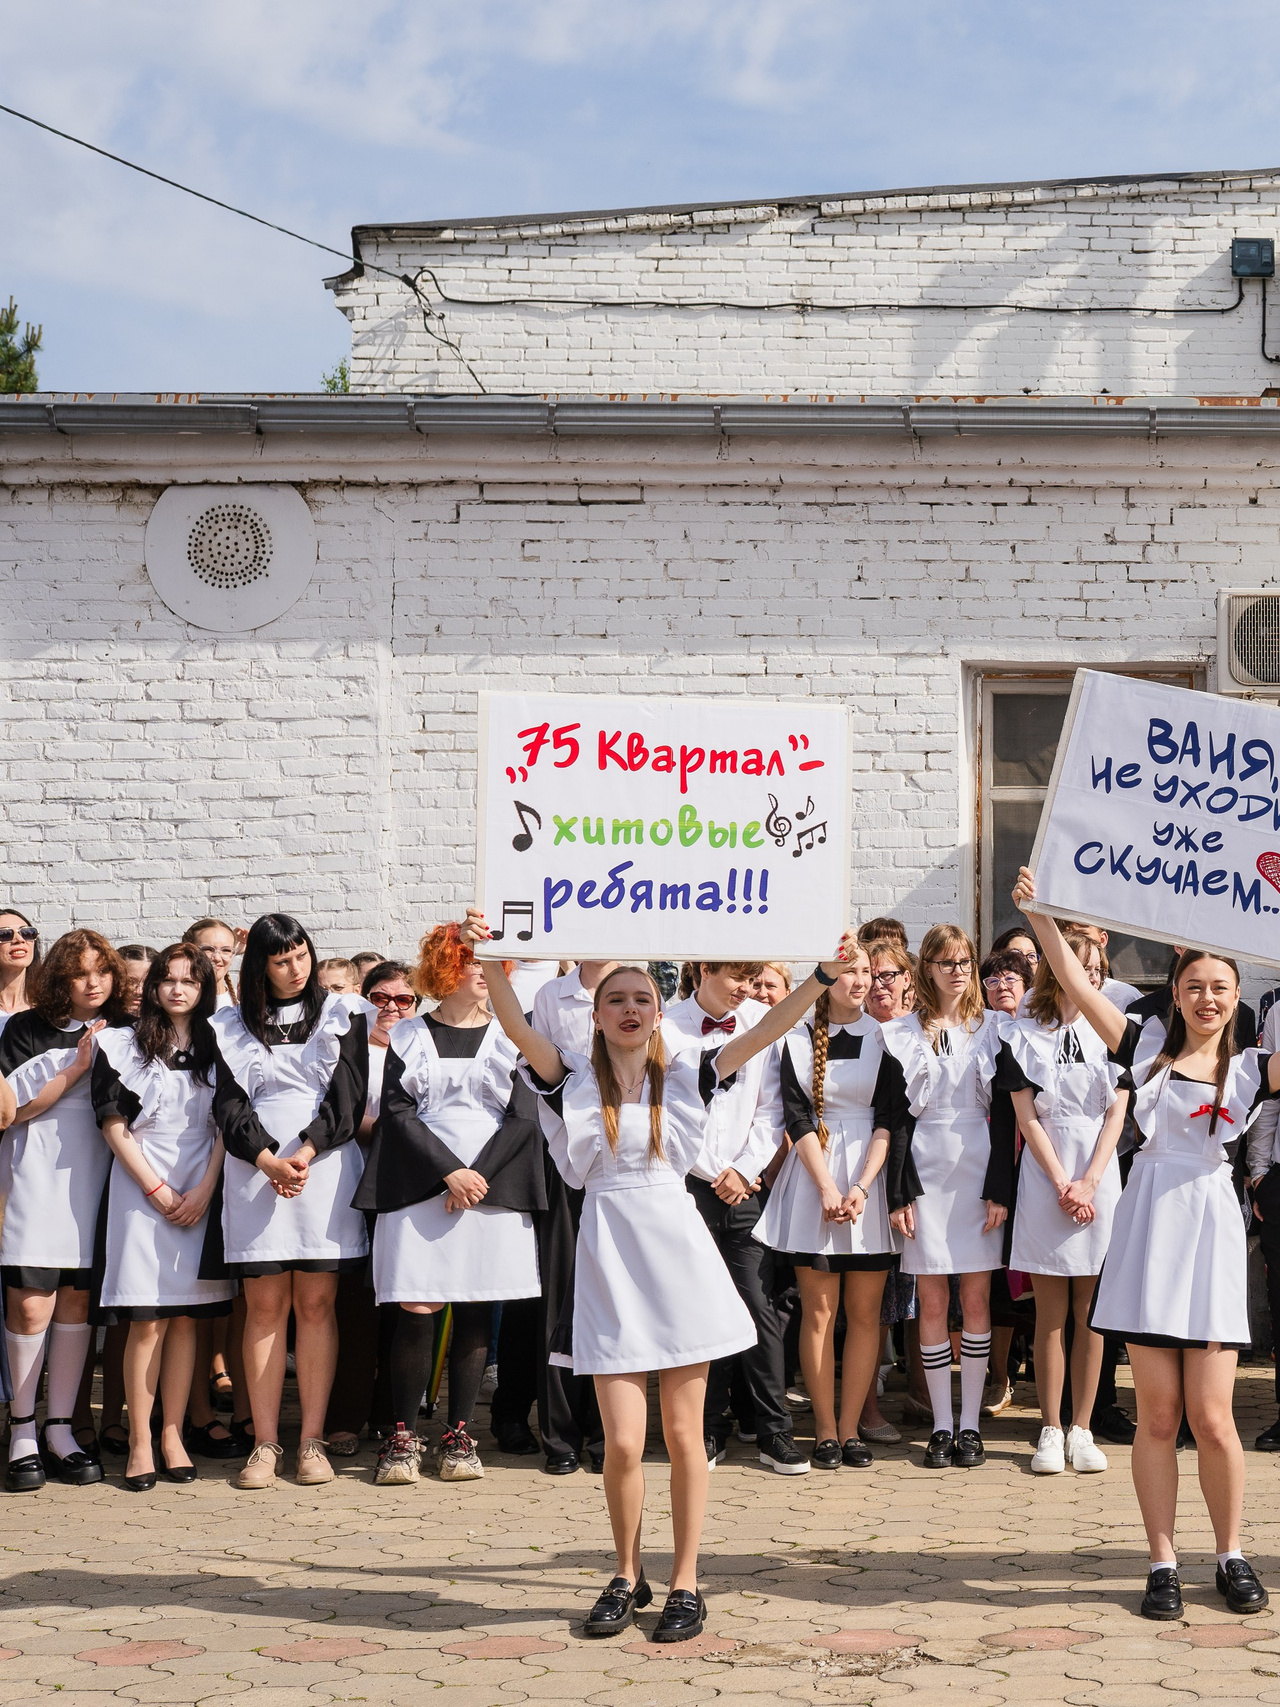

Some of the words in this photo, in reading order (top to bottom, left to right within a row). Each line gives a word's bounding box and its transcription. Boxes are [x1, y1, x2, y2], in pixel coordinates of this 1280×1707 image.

[1148, 718, 1279, 793] ВАНЯ,
[552, 804, 765, 849] хитовые
[543, 860, 770, 933] ребята!!!
